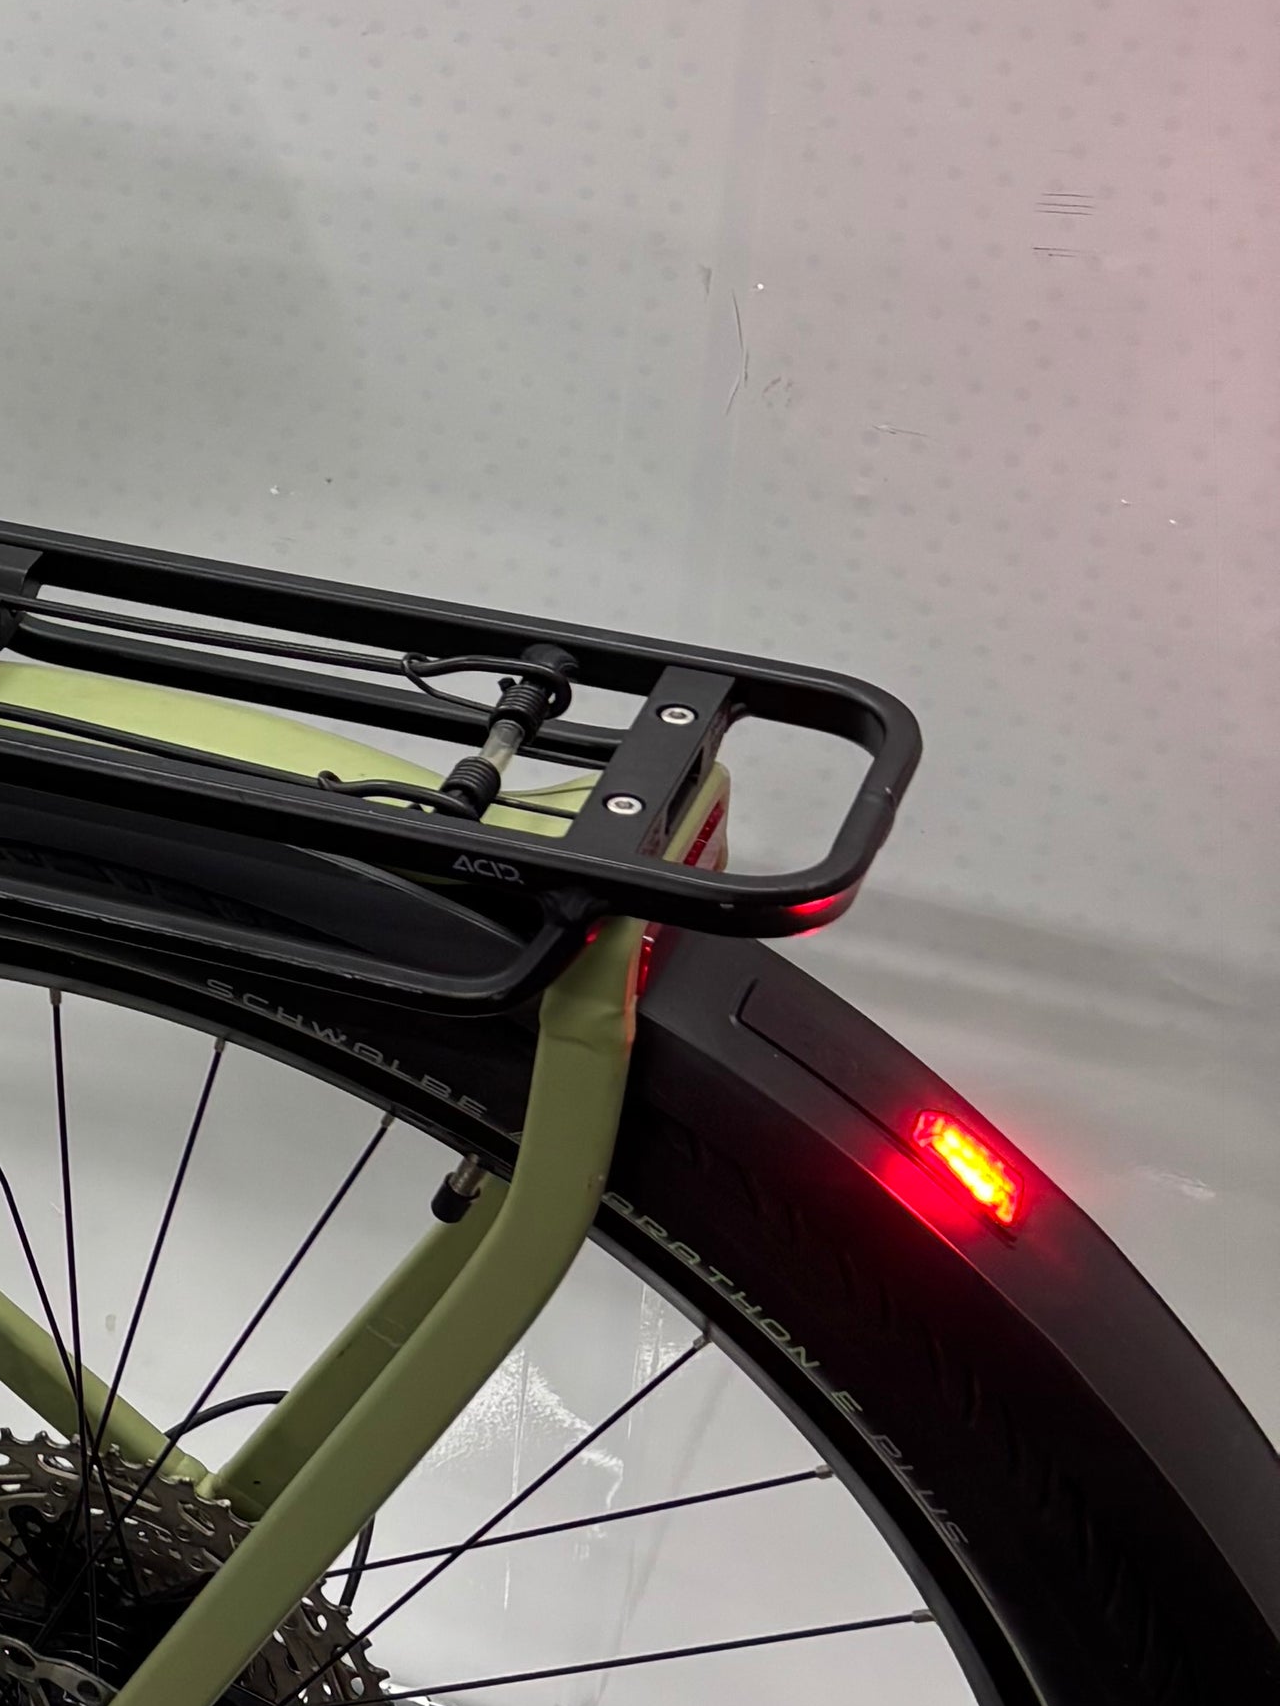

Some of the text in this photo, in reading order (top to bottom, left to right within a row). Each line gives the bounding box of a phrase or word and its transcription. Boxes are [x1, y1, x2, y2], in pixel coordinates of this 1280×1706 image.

[205, 978, 489, 1120] SCHWALBE
[595, 1183, 970, 1545] ARATHON E PLUS
